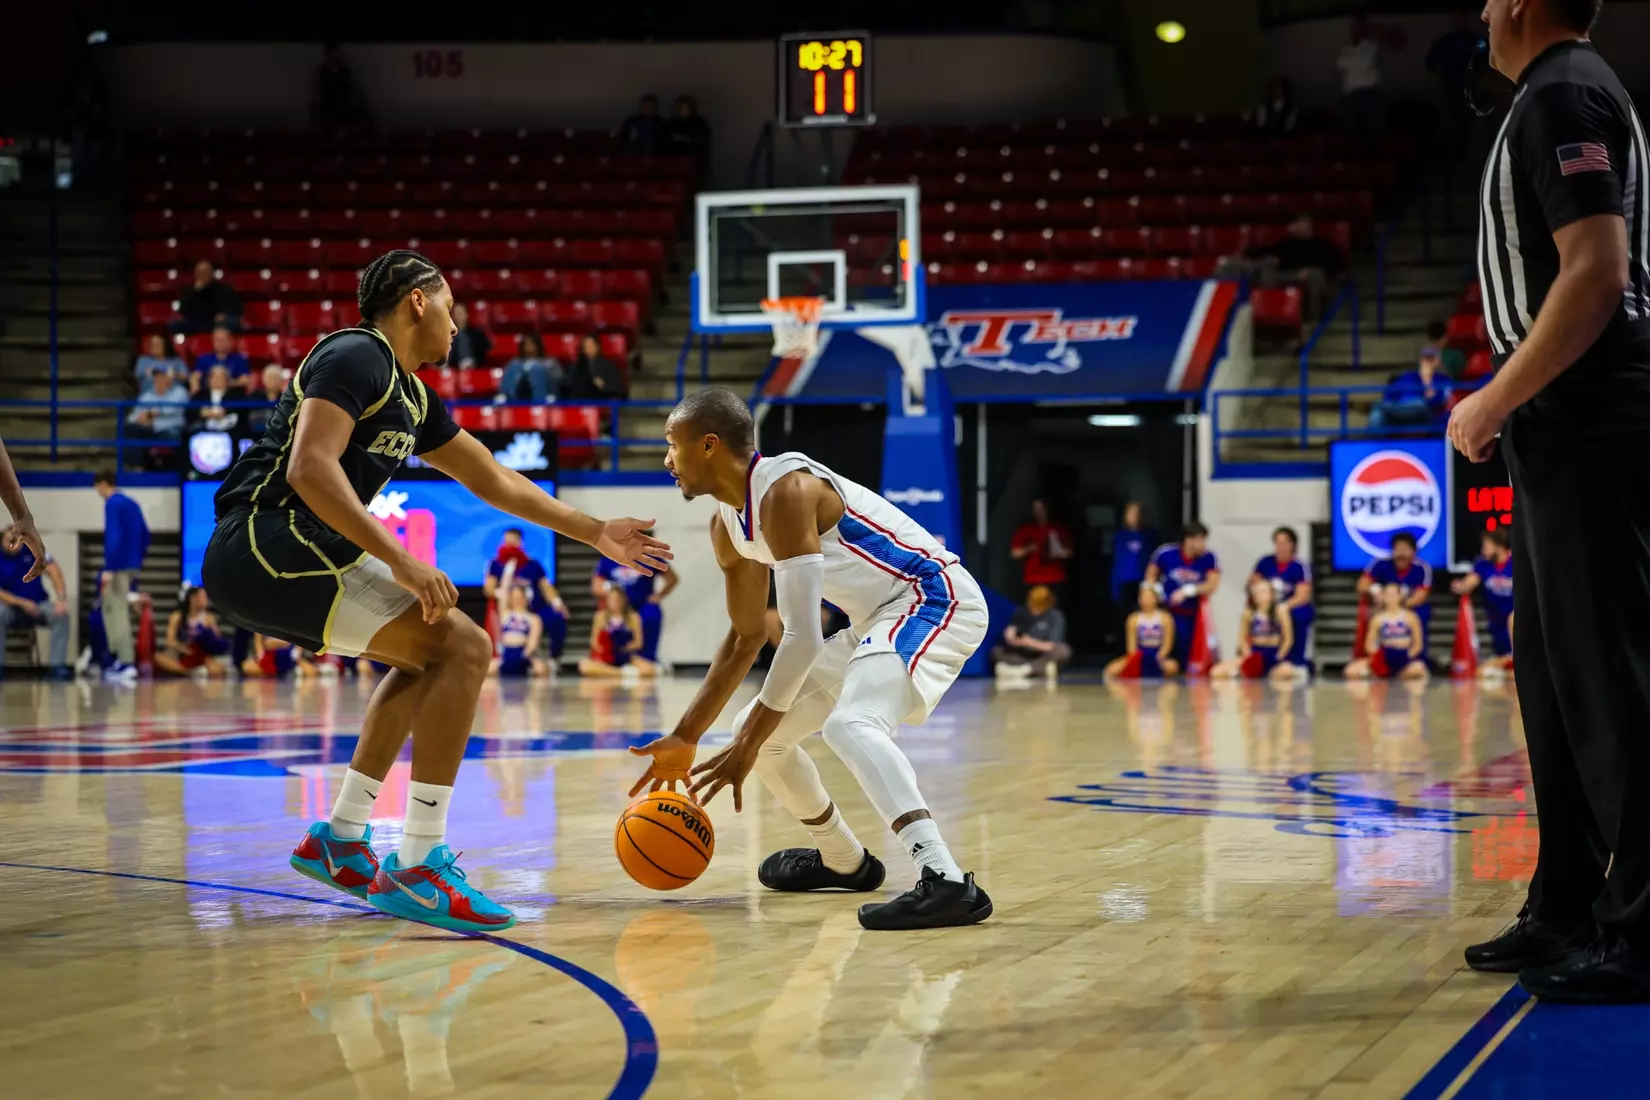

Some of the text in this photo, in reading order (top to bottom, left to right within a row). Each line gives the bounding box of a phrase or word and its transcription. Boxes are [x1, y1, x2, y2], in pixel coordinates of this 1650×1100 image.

[814, 69, 856, 115] 11
[1350, 496, 1434, 515] PEPSI
[657, 802, 711, 849] Wilson
